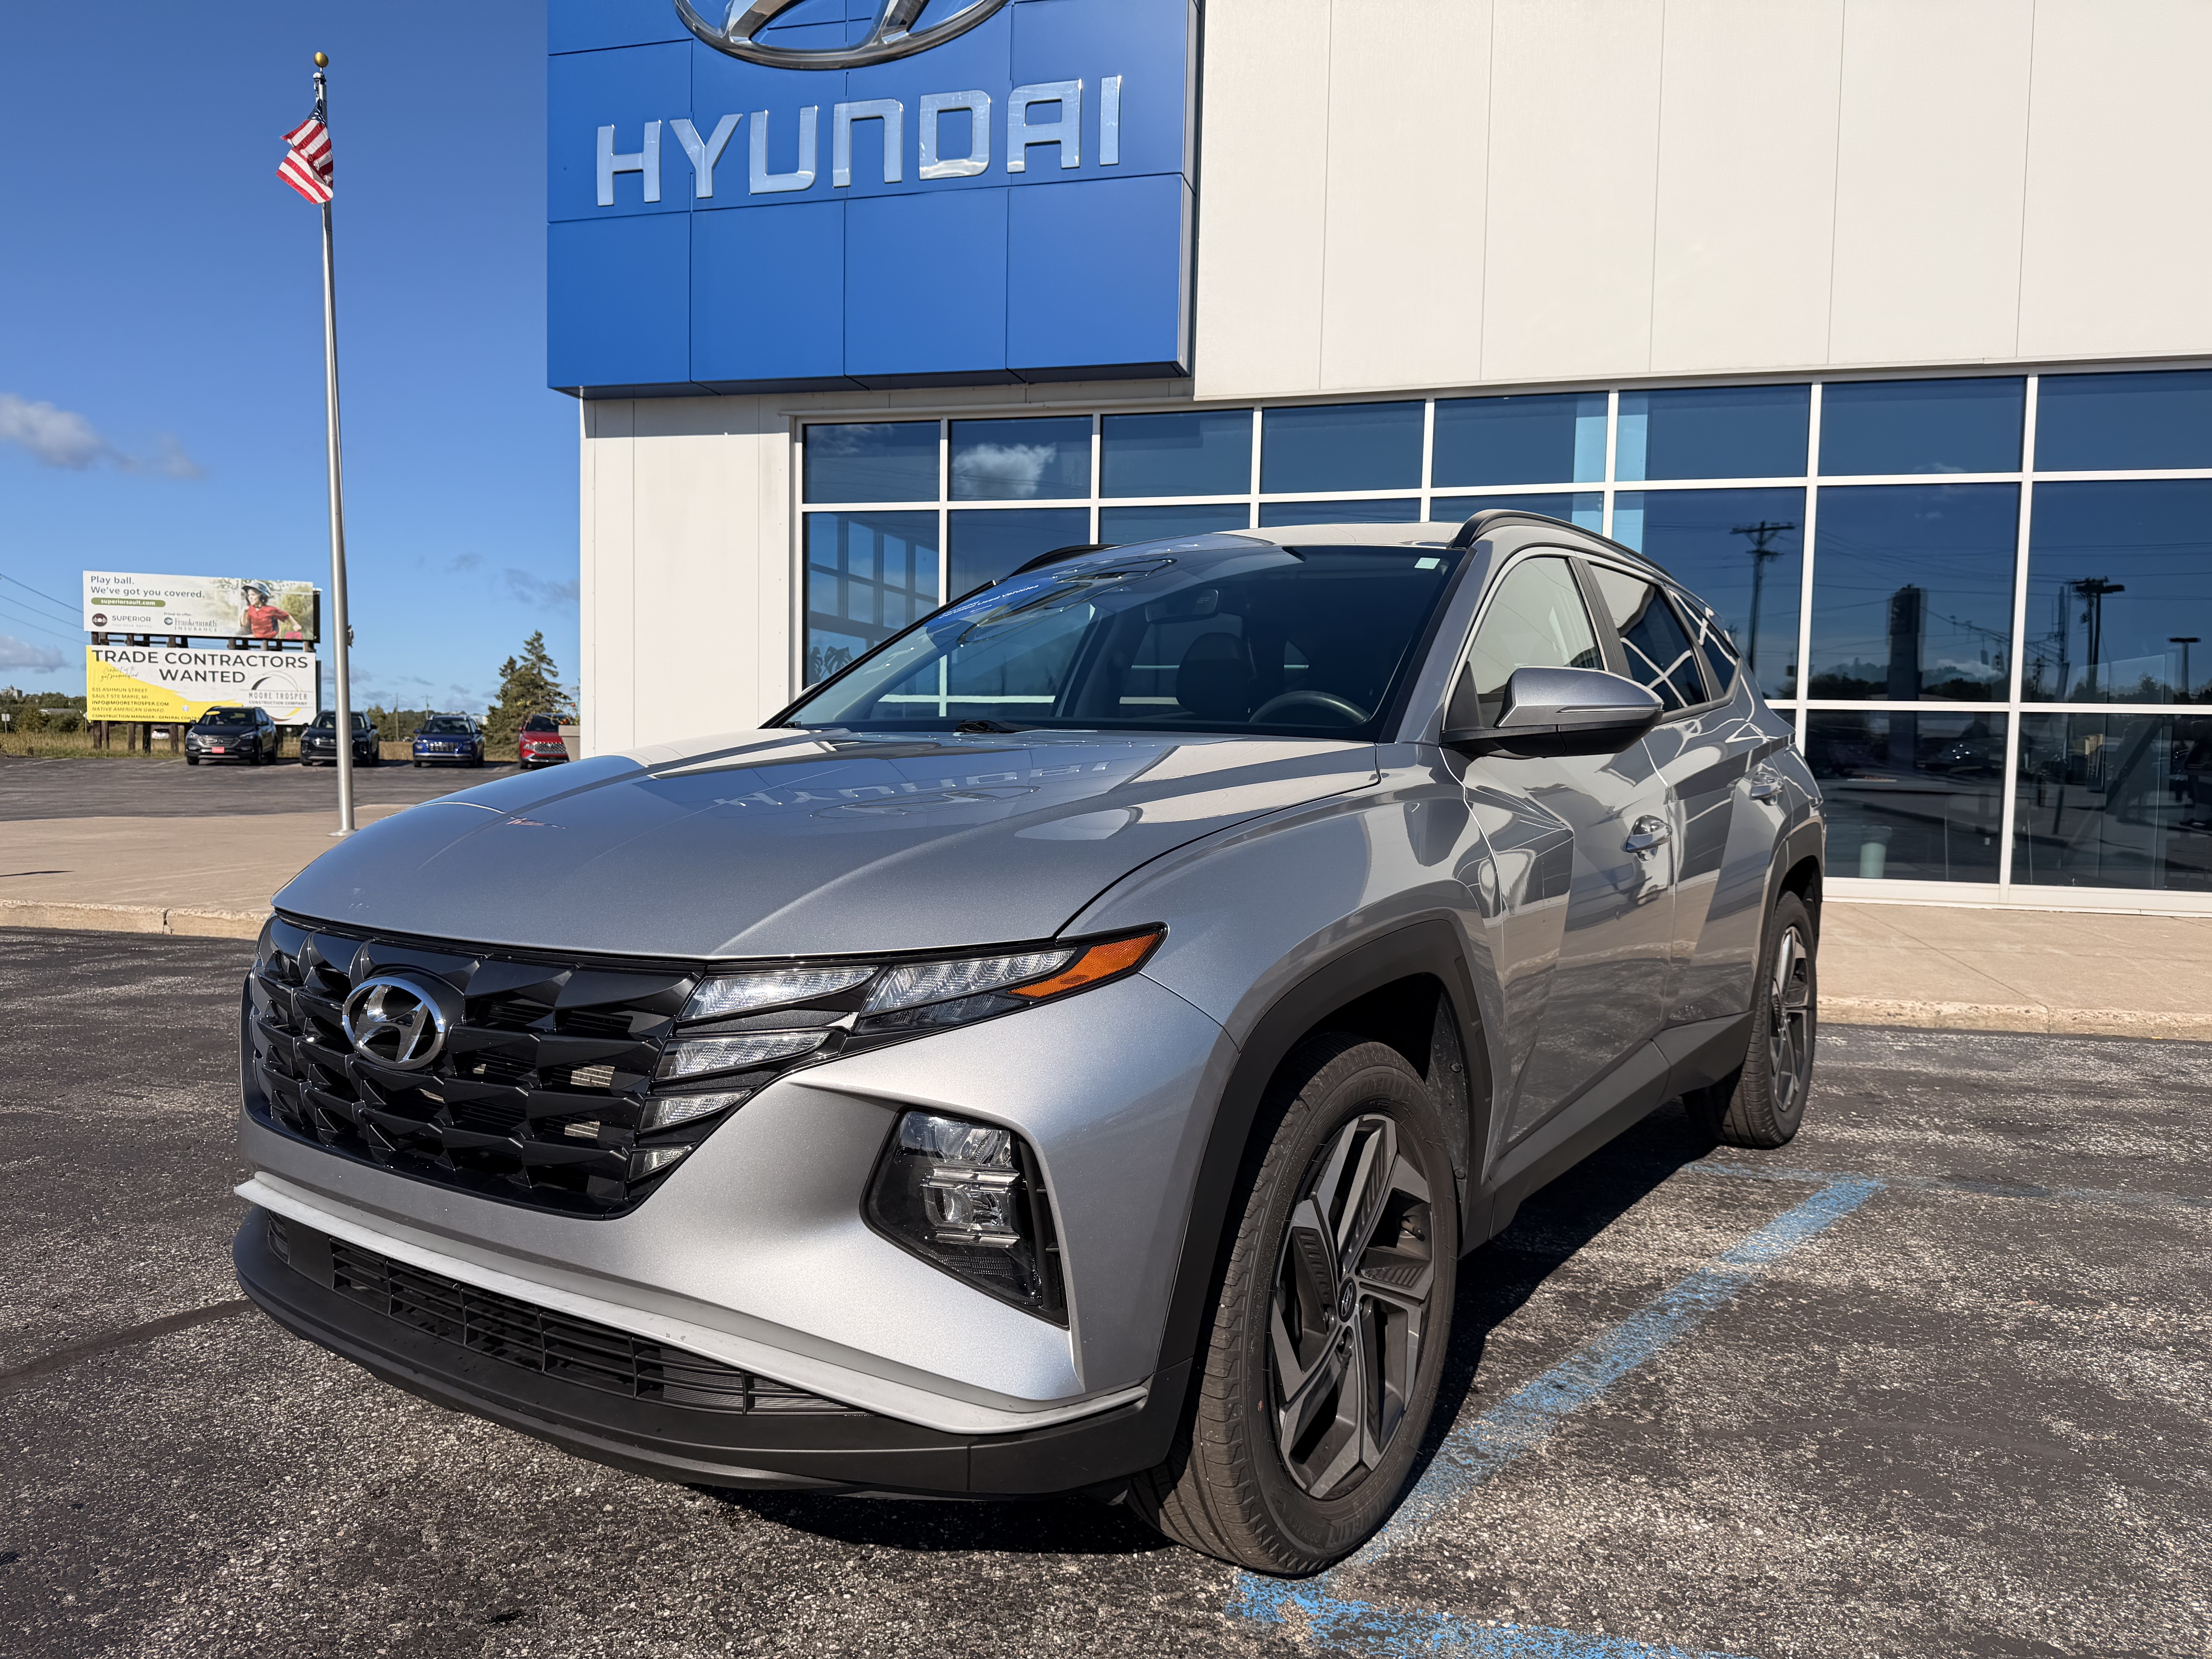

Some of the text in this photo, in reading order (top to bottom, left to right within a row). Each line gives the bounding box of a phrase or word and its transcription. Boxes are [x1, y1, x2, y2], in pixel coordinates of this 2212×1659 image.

[597, 75, 1122, 207] HYUNDAI
[91, 575, 110, 585] Play
[124, 588, 140, 596] got
[92, 650, 308, 668] TRADE CONTRACTORS
[159, 669, 246, 683] WANTED
